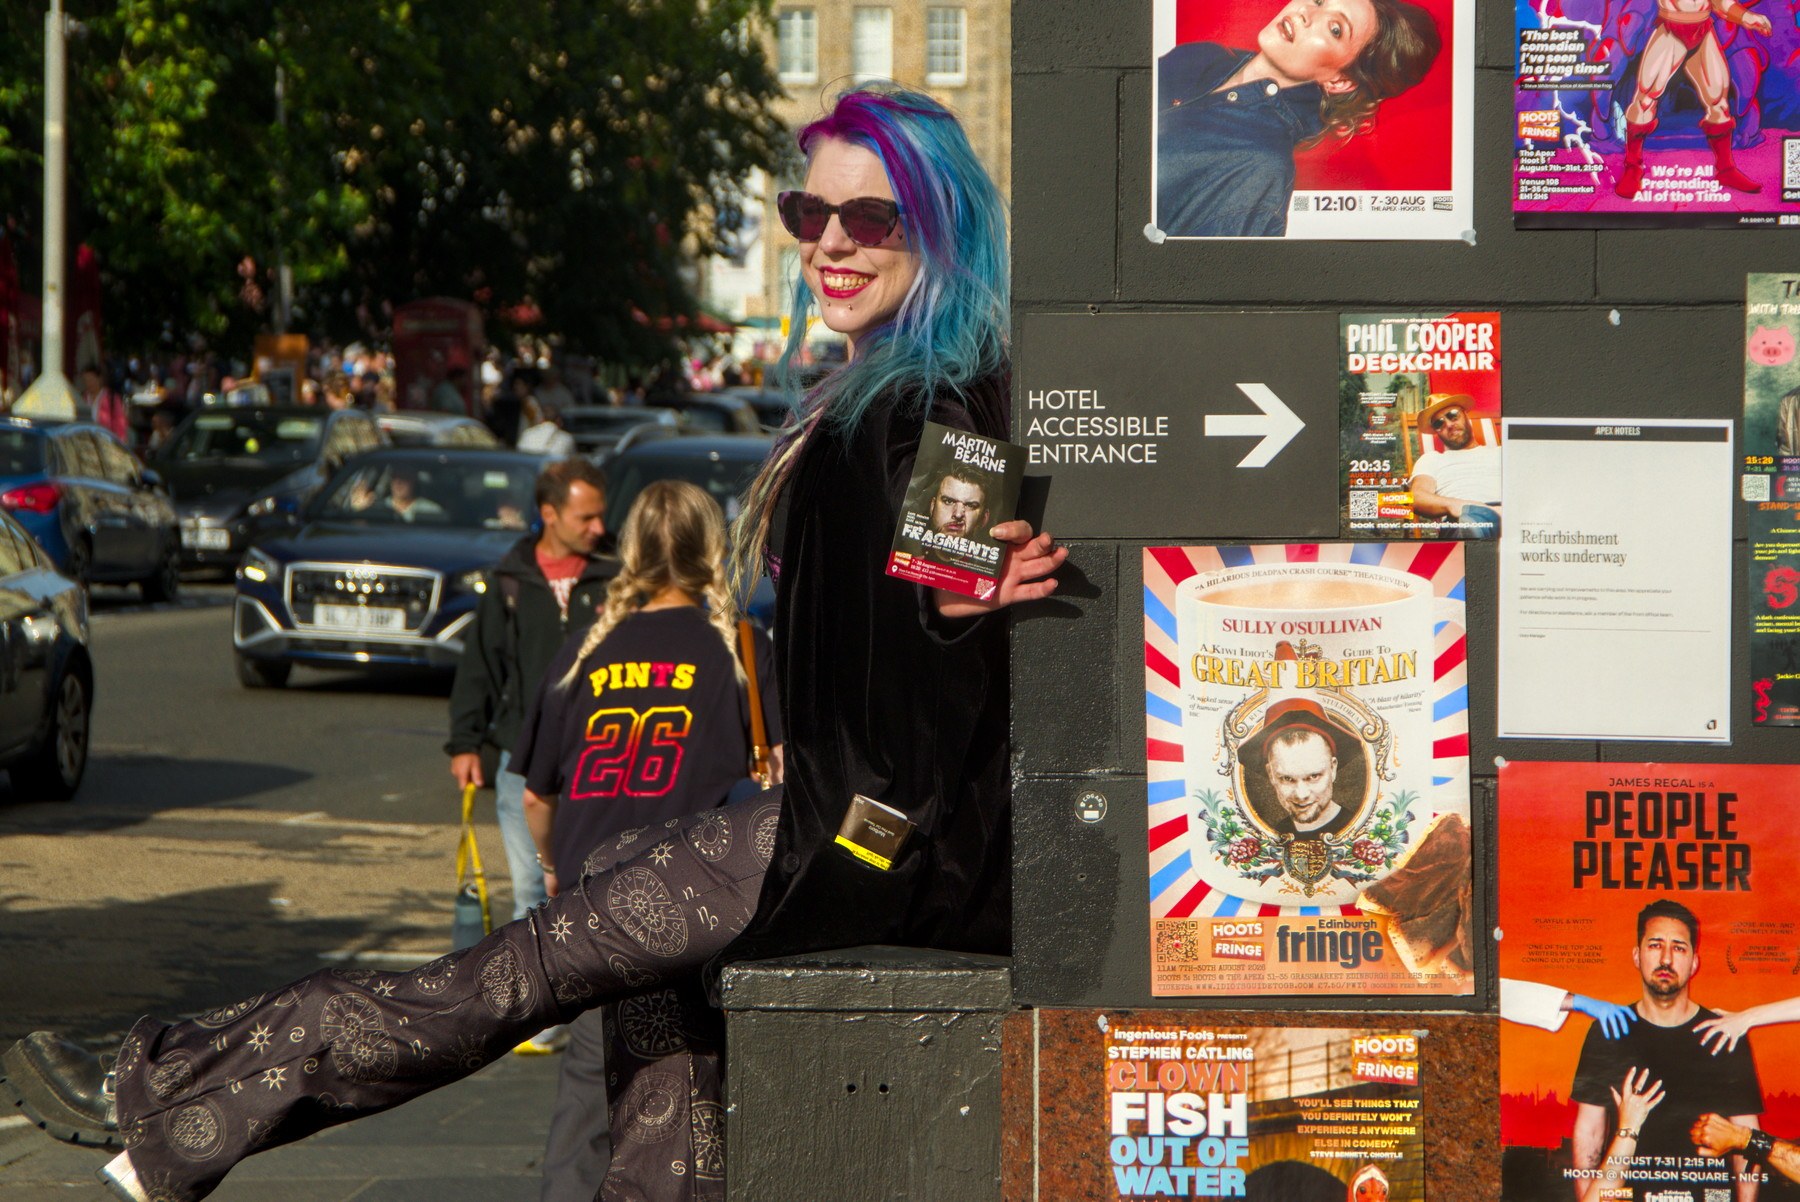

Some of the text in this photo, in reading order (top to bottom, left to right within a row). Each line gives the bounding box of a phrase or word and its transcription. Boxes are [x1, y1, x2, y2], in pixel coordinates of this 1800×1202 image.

[1522, 30, 1579, 40] 'The best
[1521, 40, 1585, 52] comedian
[1521, 52, 1577, 62] I've seen
[1521, 63, 1610, 77] in a long time'
[1521, 112, 1559, 122] HOOTS
[1522, 127, 1558, 138] FRINGE
[1535, 150, 1556, 158] Apex
[1520, 164, 1548, 173] August
[1652, 165, 1714, 177] We're All
[1642, 178, 1724, 192] Pretending,
[1371, 196, 1377, 205] 7
[1385, 196, 1398, 205] 30
[1400, 196, 1425, 205] AUG
[1632, 190, 1732, 202] All of the Time
[1314, 196, 1357, 211] 12:10
[1348, 323, 1494, 352] PHIL COOPER
[1348, 352, 1494, 372] DECKCHAIR
[1028, 390, 1106, 410] HOTEL
[1026, 416, 1168, 436] ACCESSIBLE
[1595, 426, 1640, 436] APEX HOTELS
[942, 432, 996, 457] MARTIN
[954, 446, 1006, 473] BEARNE
[1029, 444, 1158, 464] ENTRANCE
[1350, 460, 1390, 472] 20:35
[1380, 508, 1411, 516] COMEDY
[902, 524, 1000, 560] FRAGMENTS
[1521, 530, 1620, 545] Refurbishment
[1520, 548, 1628, 567] works underway
[1206, 573, 1250, 587] HILARIOUS
[1252, 569, 1288, 578] DEADPAN
[1222, 616, 1382, 635] SULLY O'SULLIVAN
[1200, 643, 1208, 652] A
[1190, 648, 1418, 689] GREAT BRITAIN
[589, 662, 696, 697] PINTS
[570, 705, 693, 800] 26
[1609, 778, 1651, 787] JAMES
[1654, 778, 1695, 788] REGAL
[1585, 790, 1739, 840] PEOPLE
[1572, 840, 1752, 892] PLEASER
[1212, 923, 1262, 937] HOOTS
[1318, 920, 1378, 930] Edinburgh
[1215, 943, 1262, 956] FRINGE
[1276, 925, 1384, 969] fringe
[1180, 1030, 1214, 1040] Fools
[1108, 1046, 1254, 1060] STEPHEN CATLING
[1354, 1038, 1416, 1054] HOOTS
[1110, 1062, 1248, 1091] CLOWN
[1357, 1062, 1414, 1080] FRINGE
[1334, 1100, 1353, 1108] SEE
[1354, 1100, 1392, 1108] THINGS
[1393, 1100, 1419, 1108] THAT
[1111, 1092, 1248, 1136] FISH
[1301, 1112, 1412, 1122] YOU DEFINITELY WON'T
[1297, 1126, 1416, 1136] EXPERIENCE ANYWHERE
[1314, 1139, 1339, 1148] ELSE
[1341, 1139, 1350, 1148] IN
[1110, 1136, 1250, 1166] OUT OF
[1606, 1156, 1725, 1168] AUGUST 7-31 2:15 PM
[1113, 1166, 1246, 1196] WATER
[1564, 1168, 1768, 1182] HOOTS @ NICOLSON SQUARE NIC 5
[1600, 1189, 1632, 1198] HOOTS
